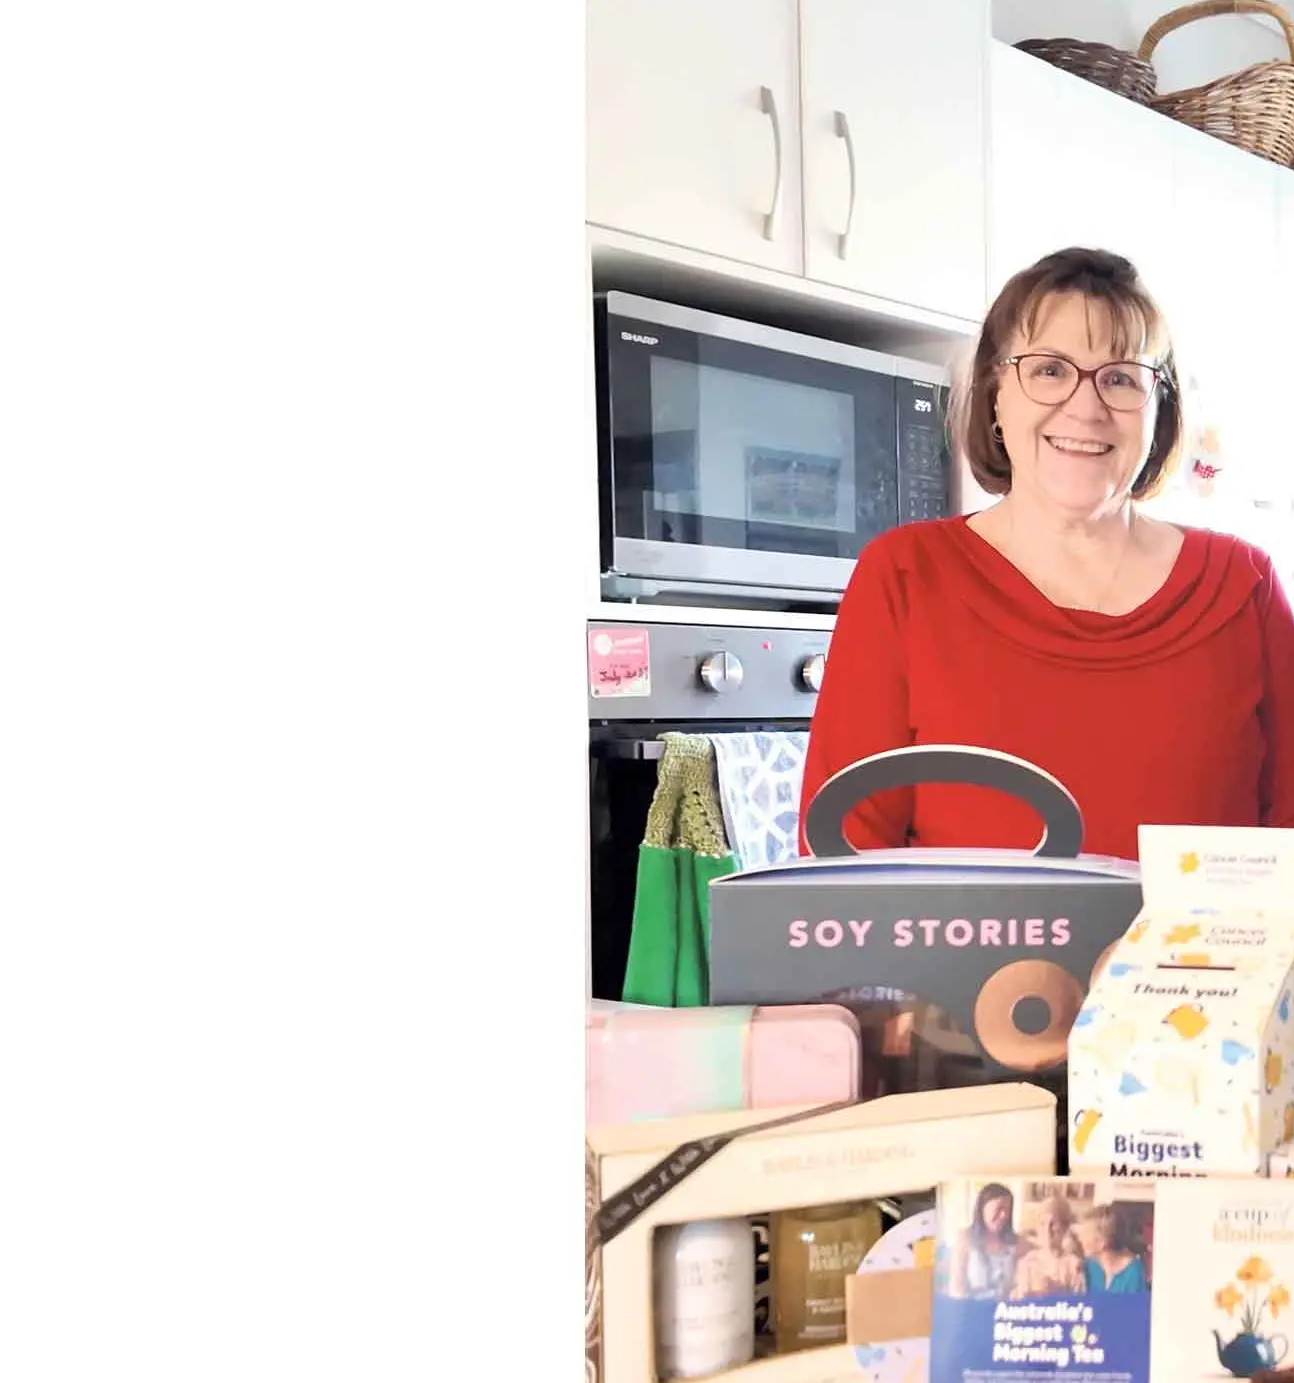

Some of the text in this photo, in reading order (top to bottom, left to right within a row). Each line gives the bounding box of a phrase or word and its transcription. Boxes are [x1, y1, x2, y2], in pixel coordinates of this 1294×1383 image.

[620, 331, 660, 346] SHARP
[788, 918, 1072, 948] SOY STORIES
[1133, 983, 1239, 1001] Thank you!
[1113, 1133, 1204, 1162] Biggest
[993, 1301, 1094, 1322] Australia's
[993, 1322, 1064, 1345] Biggest
[992, 1343, 1105, 1367] Morning Tea
